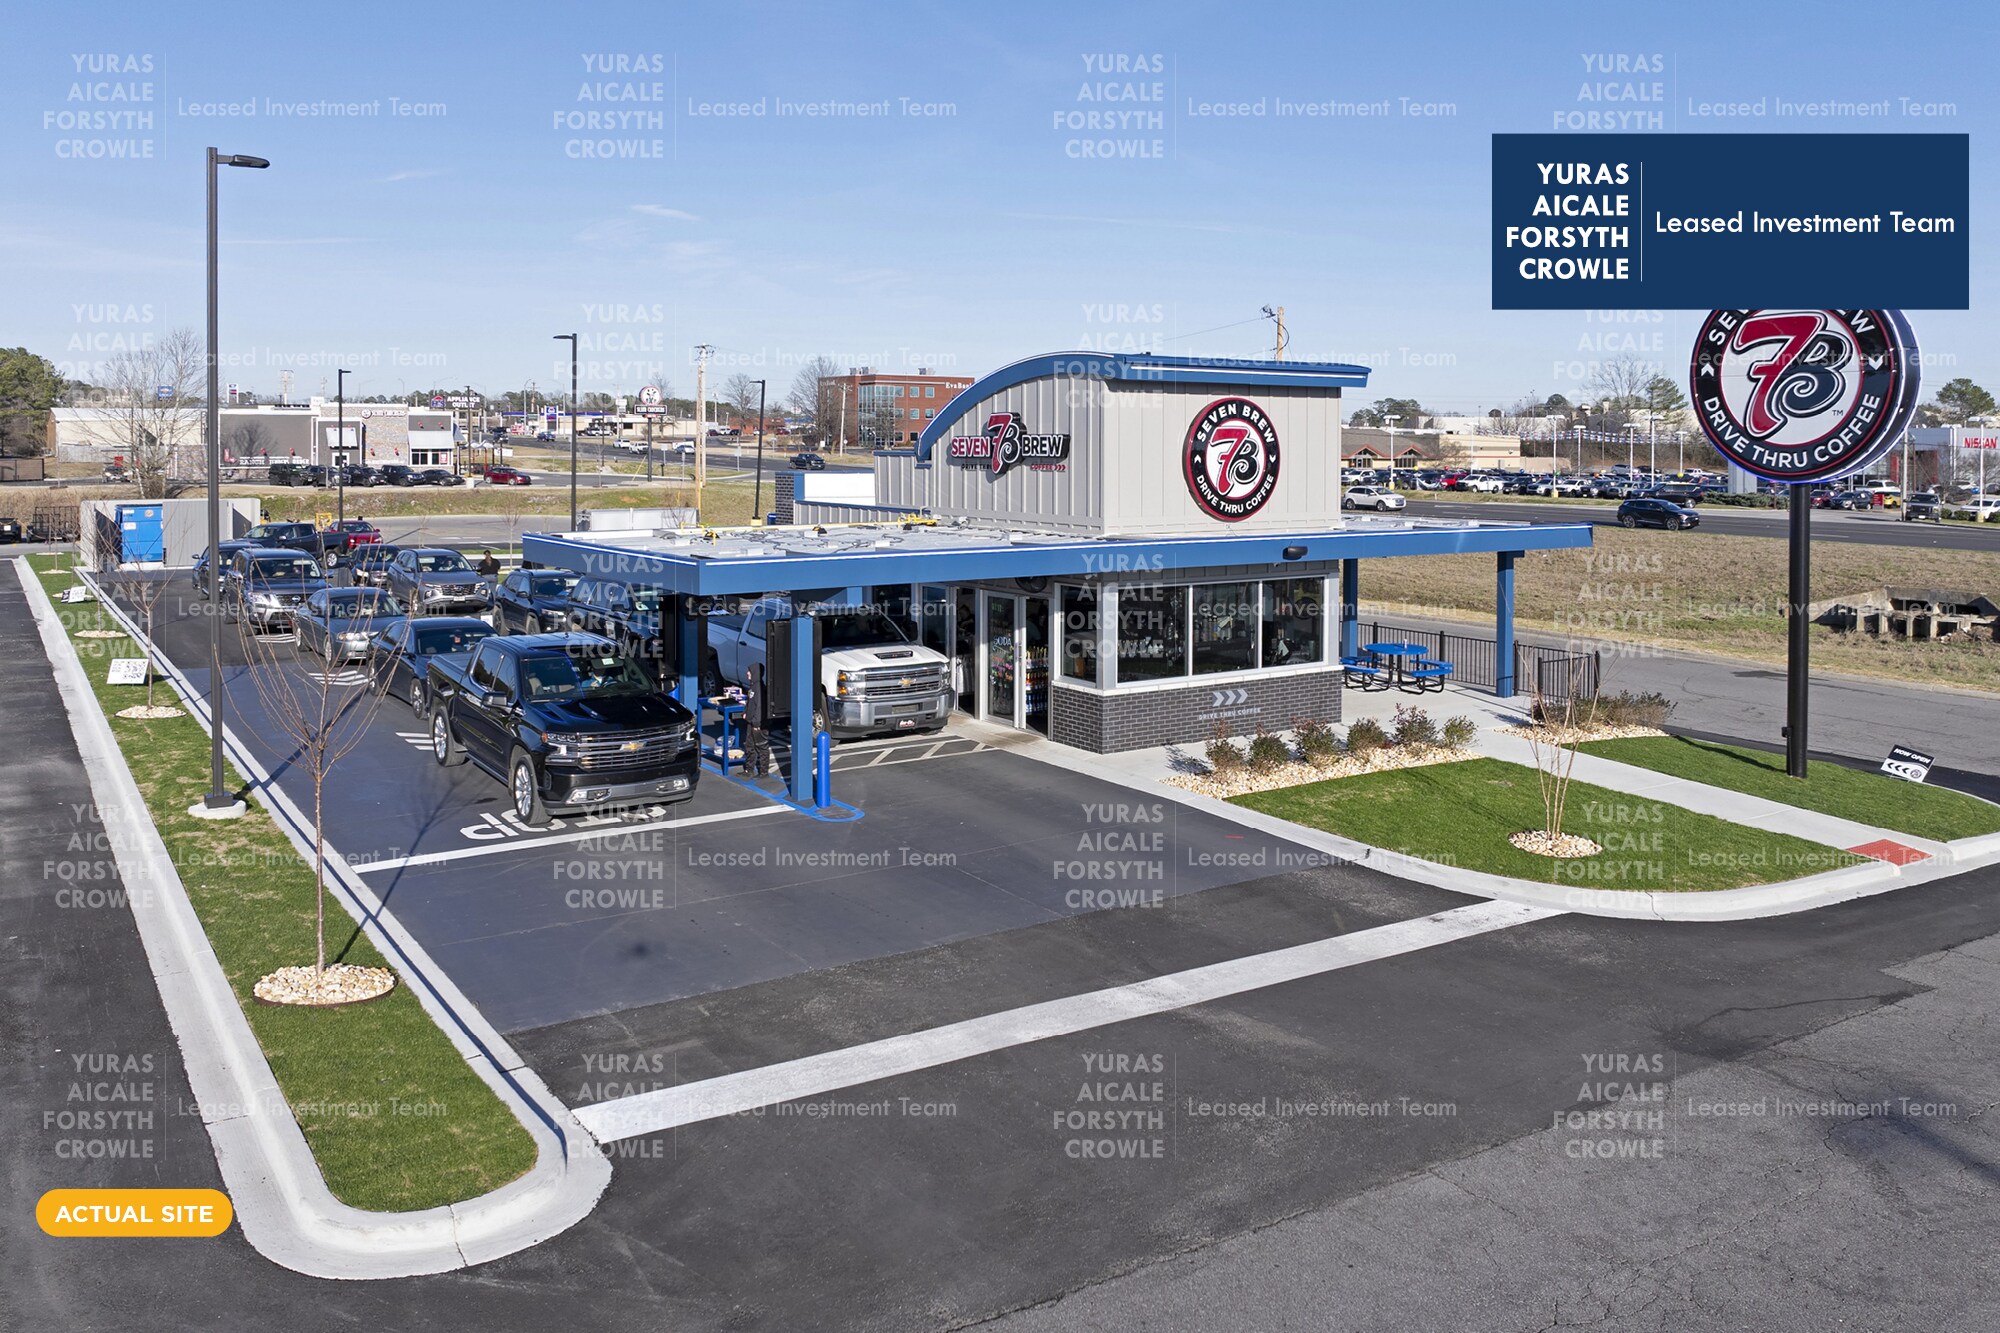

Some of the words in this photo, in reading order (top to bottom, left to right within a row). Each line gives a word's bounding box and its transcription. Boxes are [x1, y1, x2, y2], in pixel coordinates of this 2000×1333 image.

[1196, 403, 1237, 442] SEVEN
[1242, 405, 1275, 443] BREW
[1704, 396, 1750, 454] DRIVE
[1752, 444, 1808, 468] THRU
[1814, 393, 1881, 462] COFFEE
[951, 436, 990, 457] SEVEN
[1021, 434, 1063, 457] BREW
[1030, 463, 1055, 471] COFFEE
[1196, 474, 1219, 507] DRIVE
[1219, 501, 1244, 514] THRU
[1245, 473, 1275, 510] COFFEE
[1199, 712, 1218, 720] DRIVE
[1220, 709, 1236, 718] THRU
[1238, 707, 1261, 715] COFFEE
[1893, 748, 1912, 757] NOW
[1911, 753, 1931, 764] OPEN
